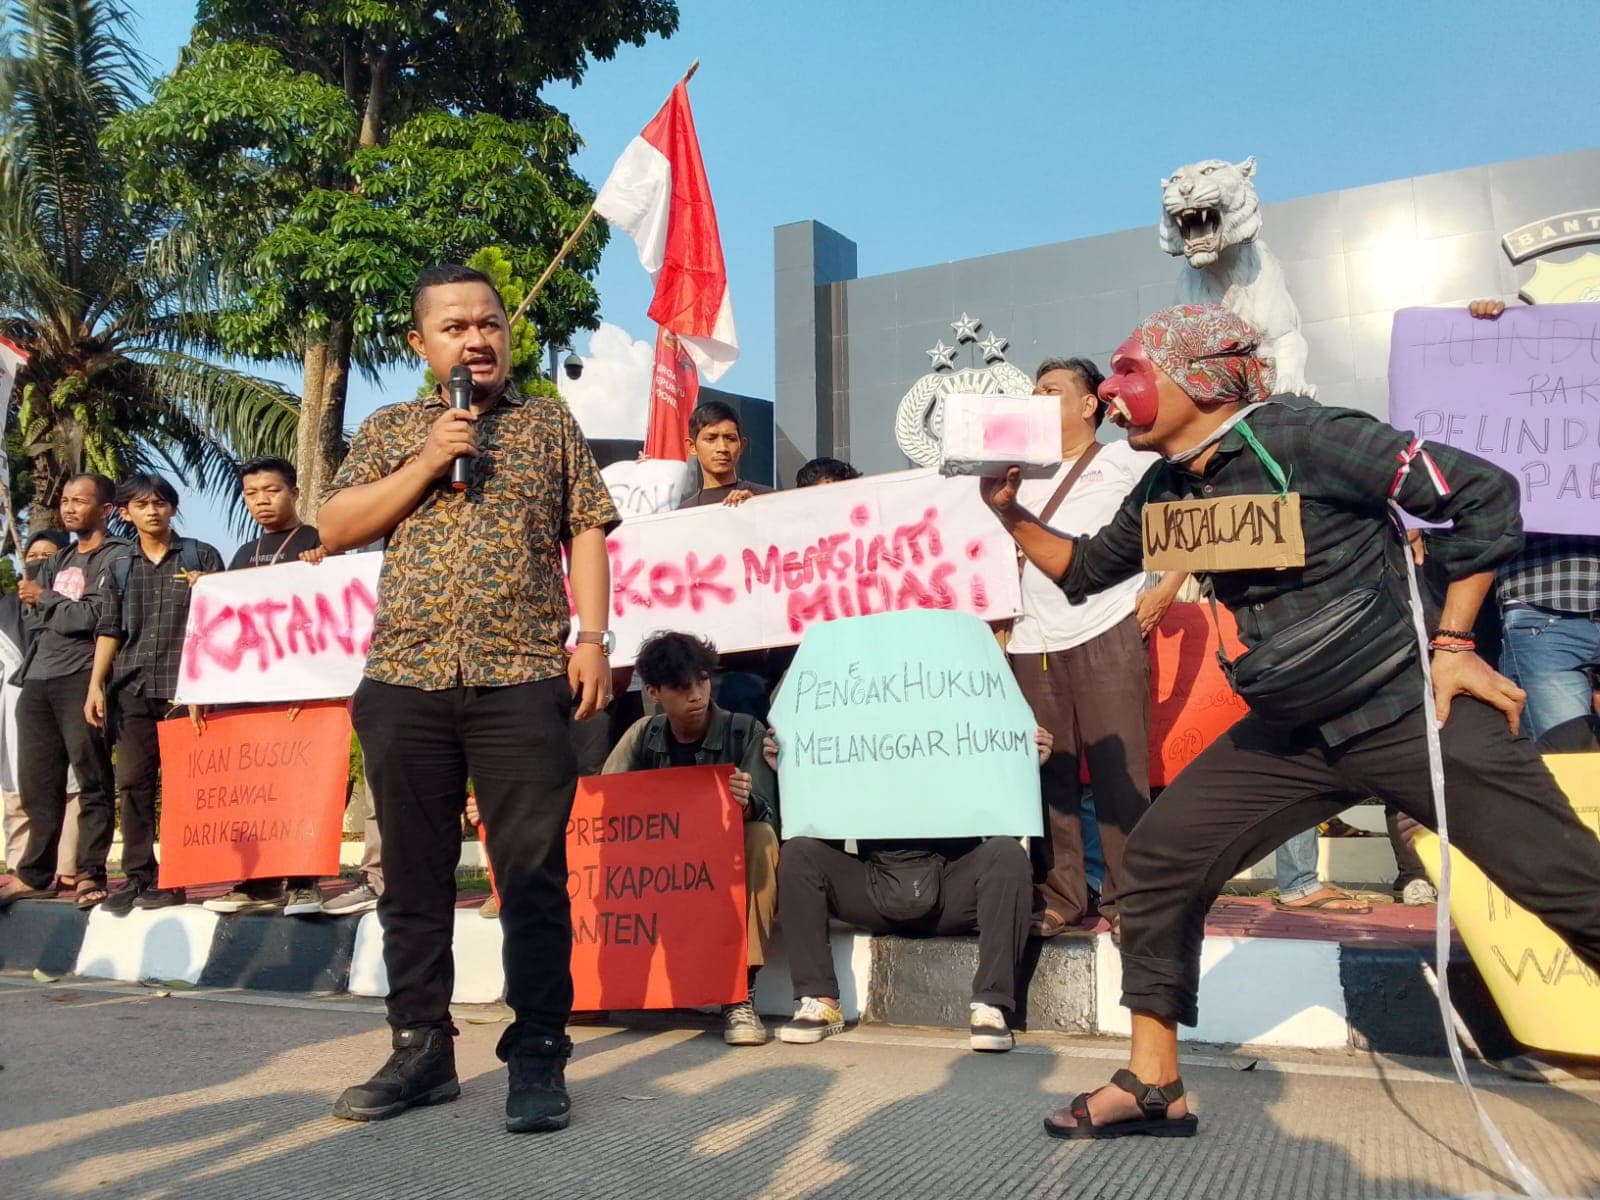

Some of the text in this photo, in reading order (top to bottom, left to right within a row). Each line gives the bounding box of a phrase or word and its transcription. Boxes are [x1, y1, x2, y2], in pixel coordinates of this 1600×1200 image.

[1415, 410, 1600, 454] PELIND
[612, 550, 735, 618] KOK
[903, 661, 1006, 703] HUKUM
[188, 741, 312, 778] IKAN BUSUK
[795, 721, 1030, 767] MELANGGAR HUKUM
[196, 783, 279, 811] BERAWAL
[566, 811, 681, 847] PRESIDEN
[605, 860, 716, 901] KAPOLDA
[1490, 943, 1600, 987] WA
